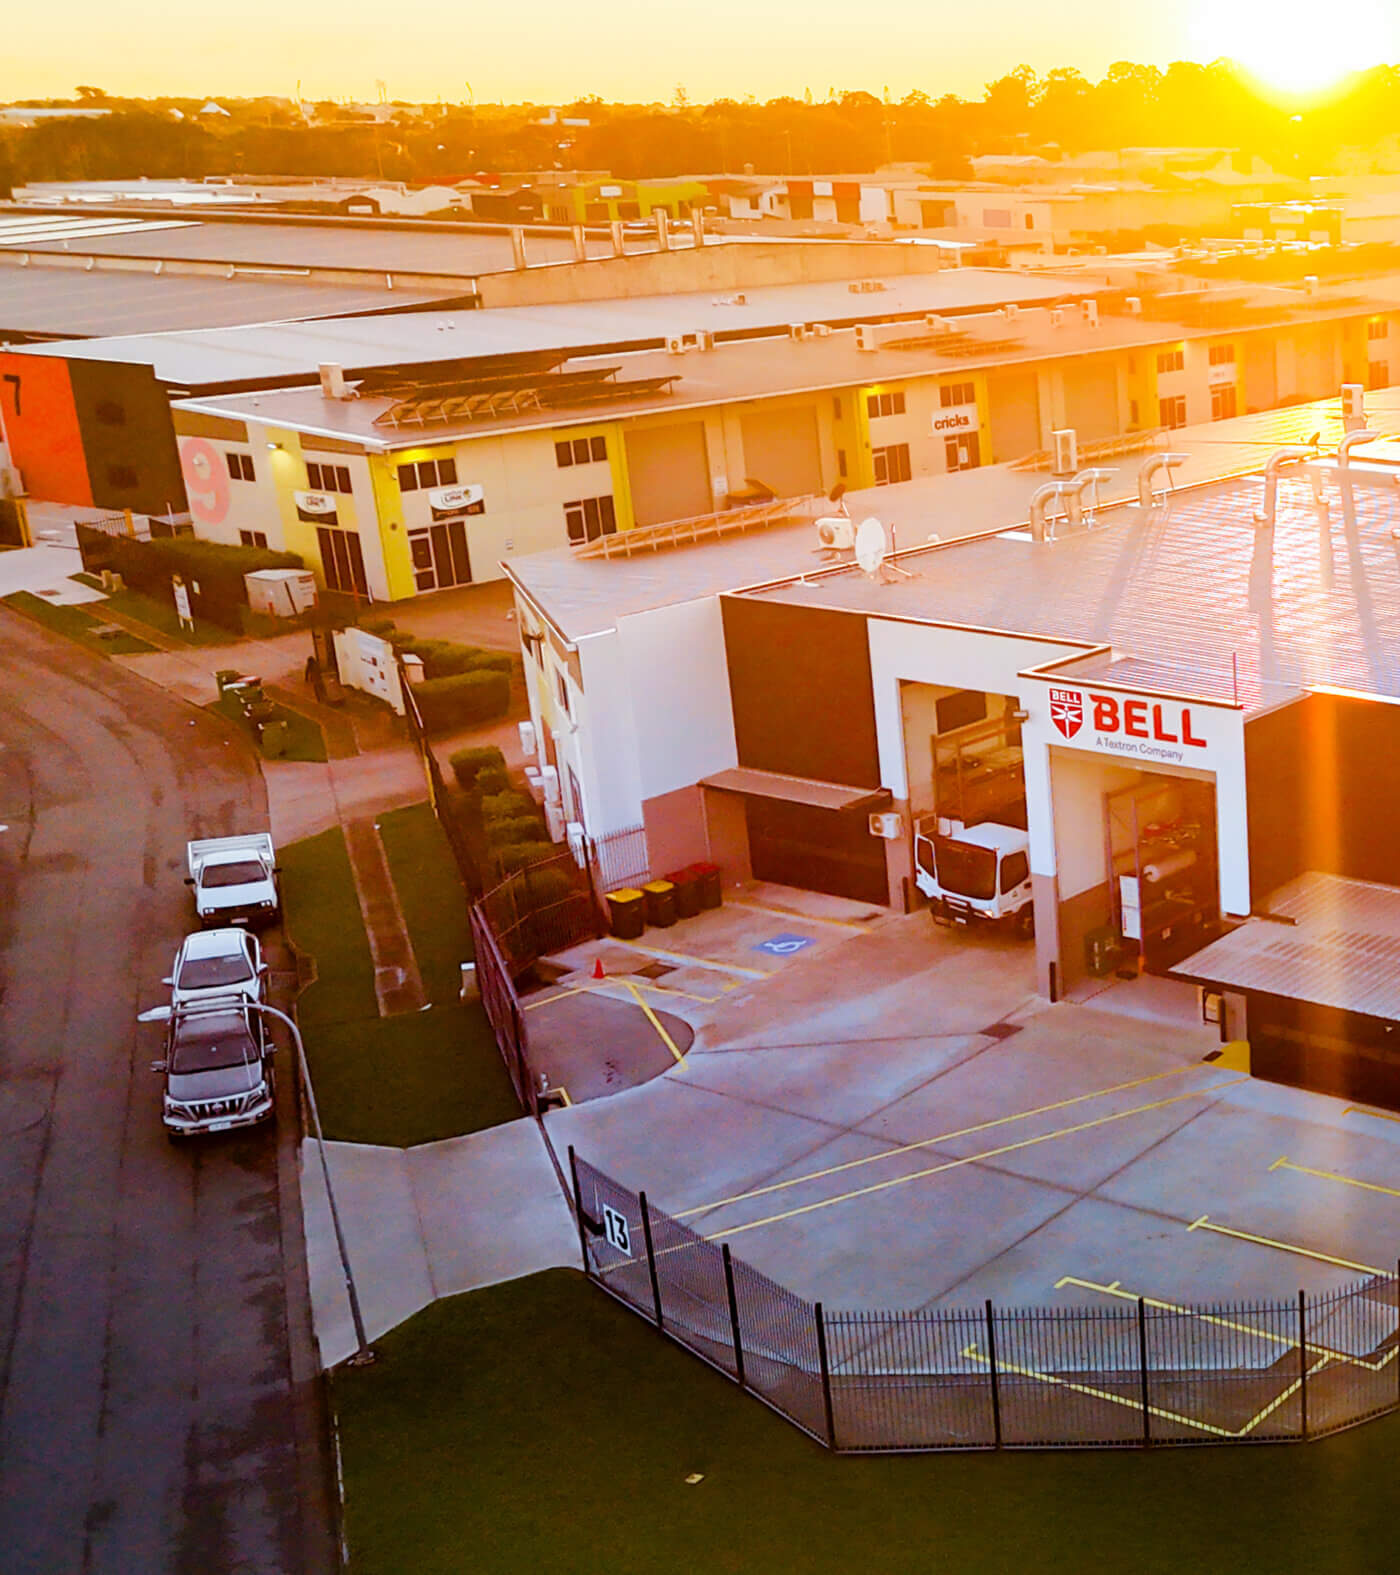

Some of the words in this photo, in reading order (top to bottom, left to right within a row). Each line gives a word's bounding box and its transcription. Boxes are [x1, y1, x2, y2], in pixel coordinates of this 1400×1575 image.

[4, 374, 21, 416] 7
[934, 413, 969, 430] cricks
[181, 437, 231, 526] 9
[1051, 690, 1081, 704] BELL
[1088, 694, 1207, 748] BELL
[1096, 736, 1103, 746] A
[1104, 737, 1138, 752] Textron
[1139, 743, 1184, 762] Company
[605, 1209, 629, 1250] 13
